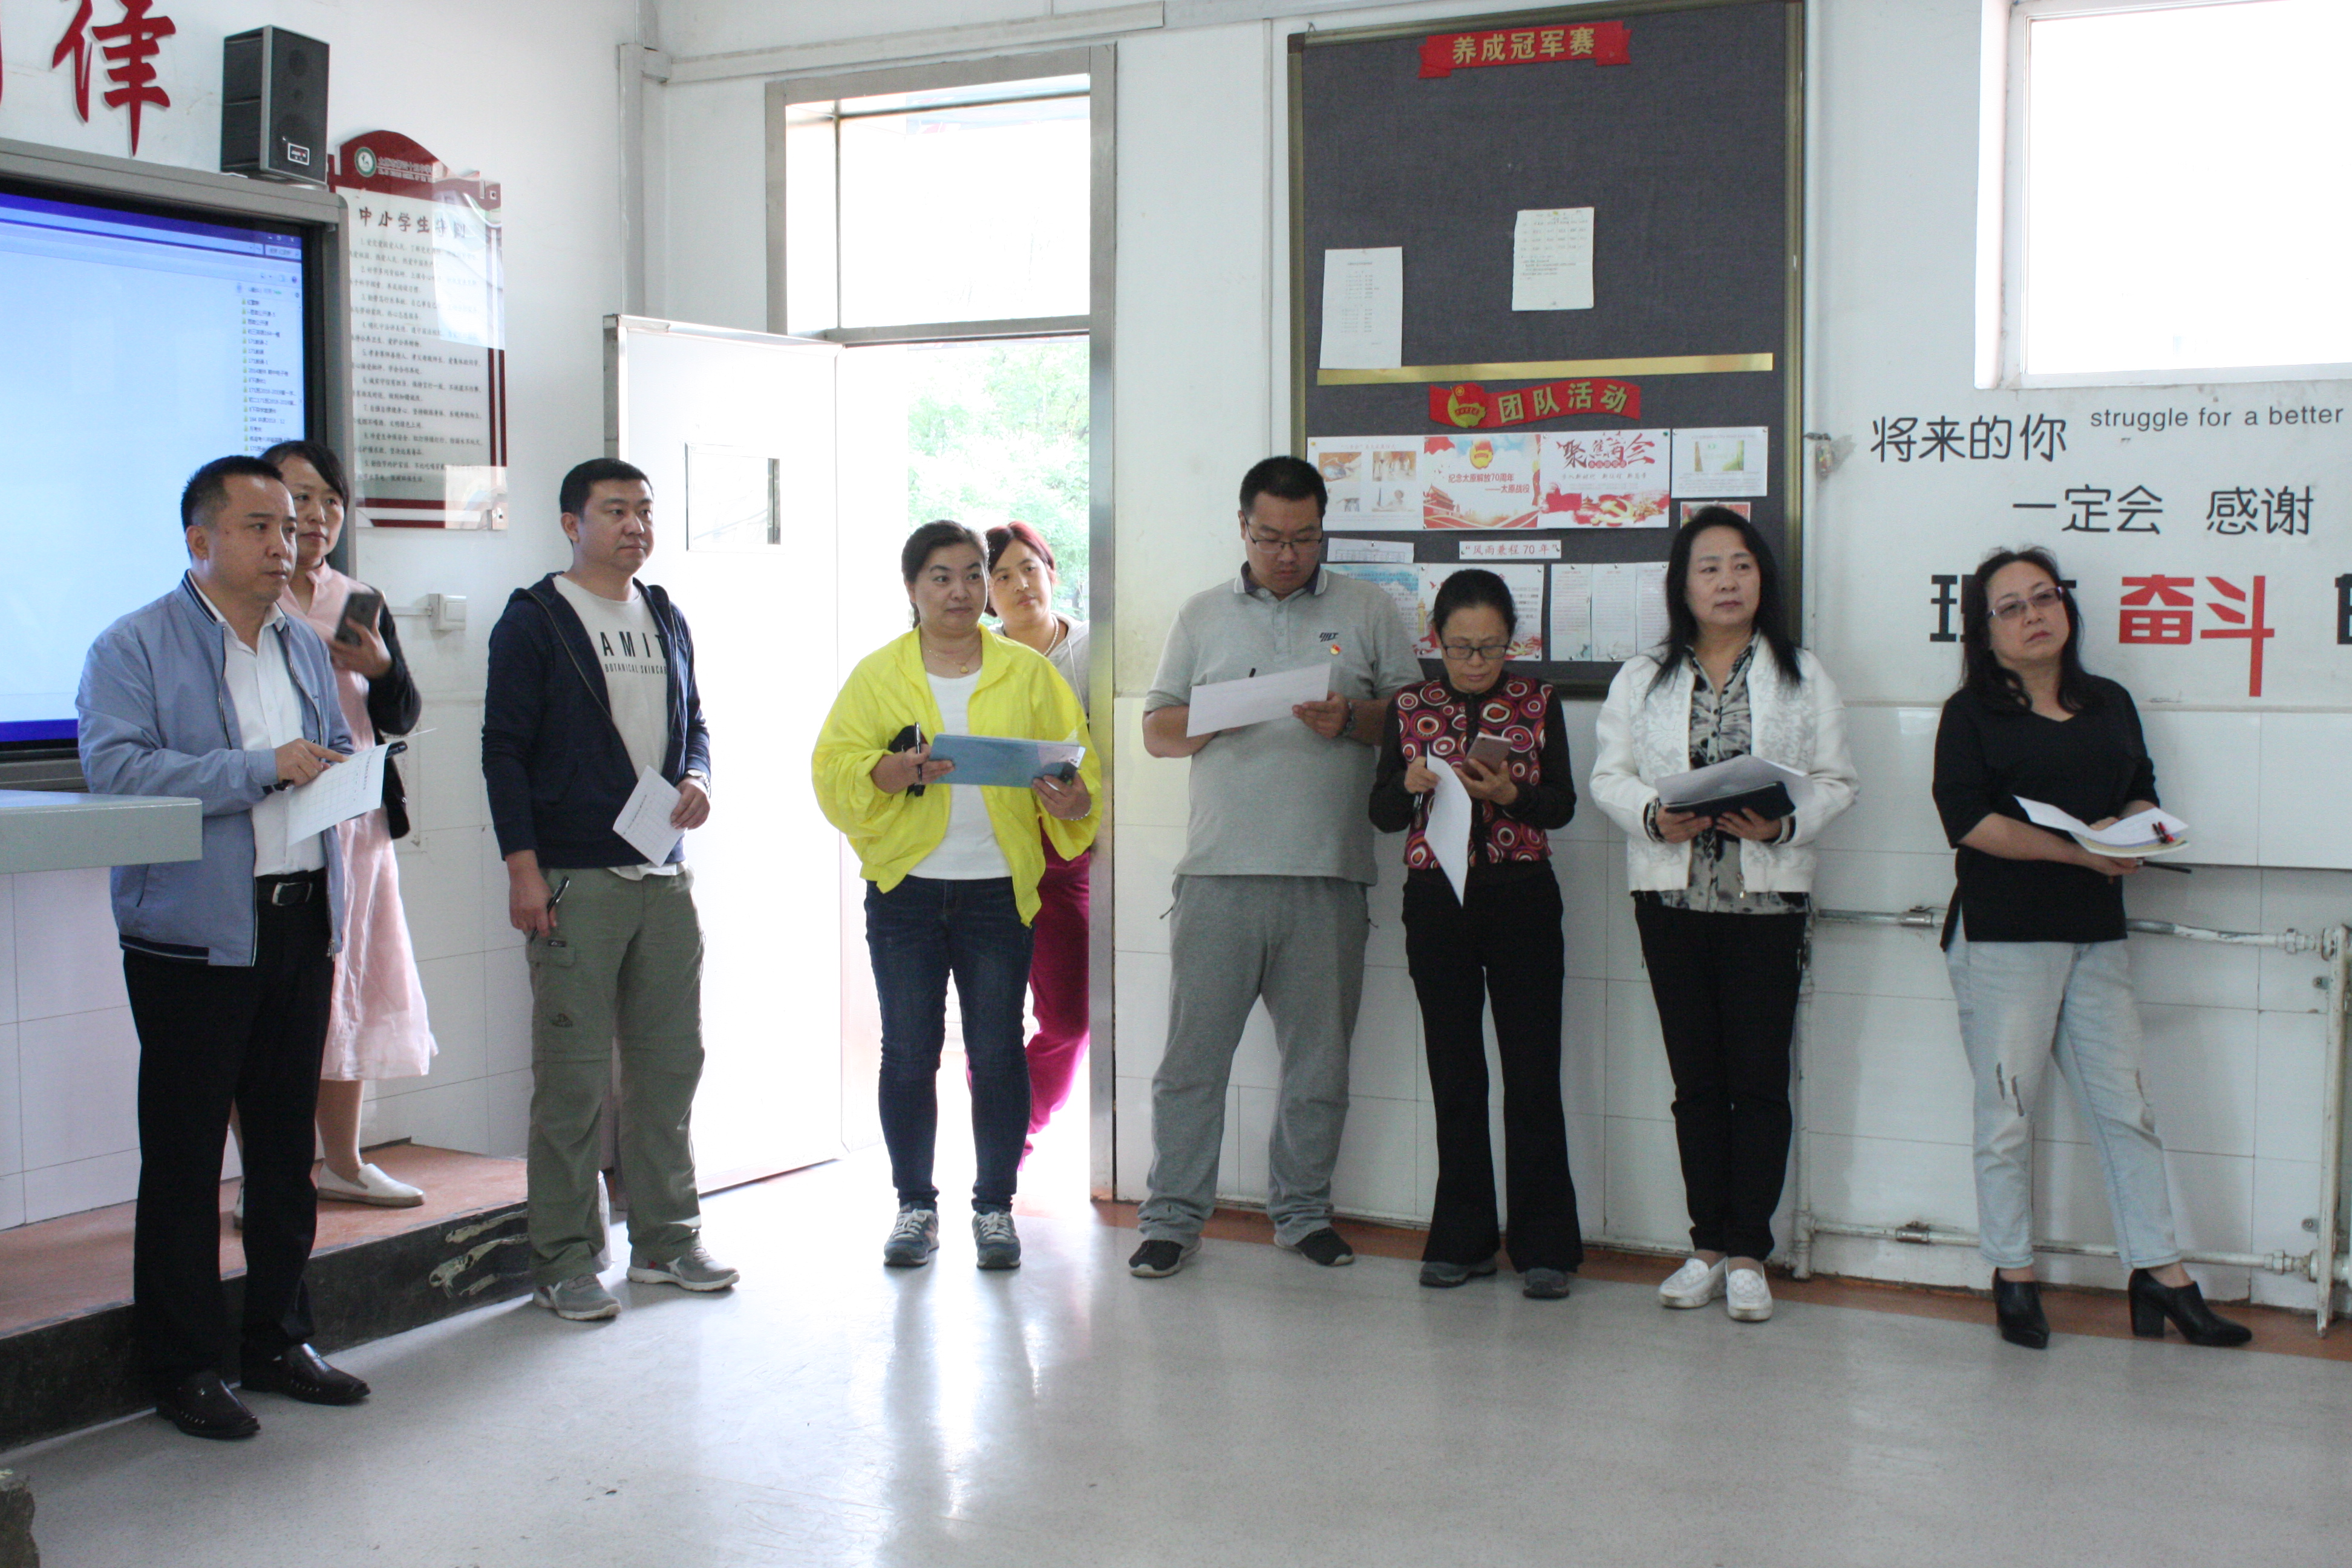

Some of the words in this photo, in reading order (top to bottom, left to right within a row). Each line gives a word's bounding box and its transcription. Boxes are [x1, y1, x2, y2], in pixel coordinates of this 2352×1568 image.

[1452, 27, 1596, 65] 养成冠军赛
[1497, 381, 1628, 423] 团队活动
[2091, 407, 2189, 432] struggle
[2199, 407, 2232, 427] for
[2244, 411, 2259, 426] a
[2269, 405, 2344, 426] better
[1870, 413, 2067, 463] 将来的你
[1448, 473, 1515, 483] 纪念太原解放70周年
[2013, 485, 2164, 535] 一定会
[2206, 485, 2315, 537] 感谢
[2118, 573, 2276, 698] 奋斗
[605, 663, 638, 673] BOTANICAL
